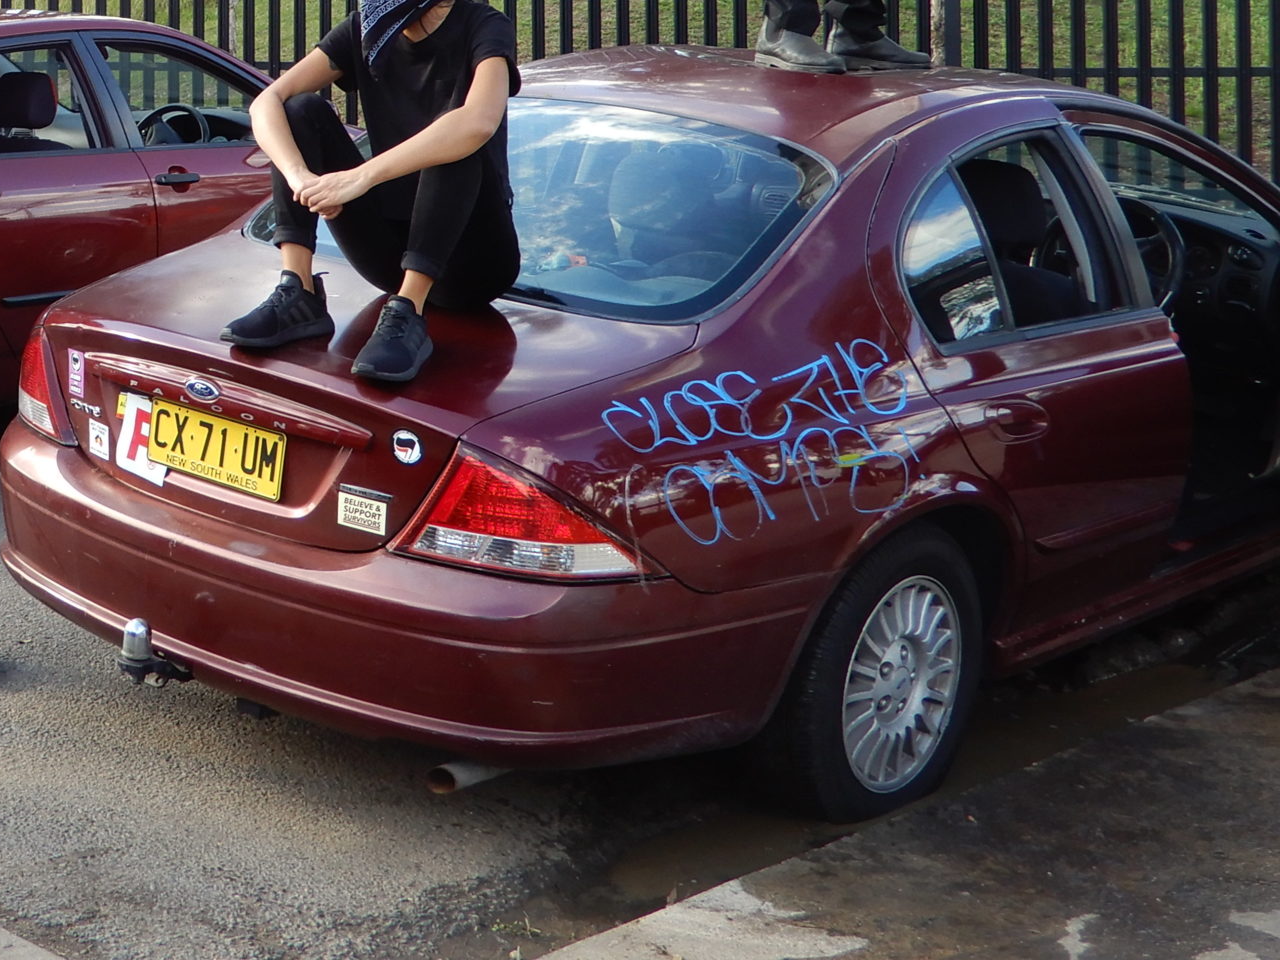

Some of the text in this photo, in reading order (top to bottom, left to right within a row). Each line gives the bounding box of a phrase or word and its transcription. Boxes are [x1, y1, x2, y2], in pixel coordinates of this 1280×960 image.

[129, 379, 288, 431] FALCON
[601, 338, 908, 453] CLOSE THE
[165, 453, 258, 492] NEW SOUTH WALES
[343, 505, 382, 521] SUPPORT
[344, 497, 382, 512] BELIEVE &
[343, 514, 381, 528] SURVIVORS
